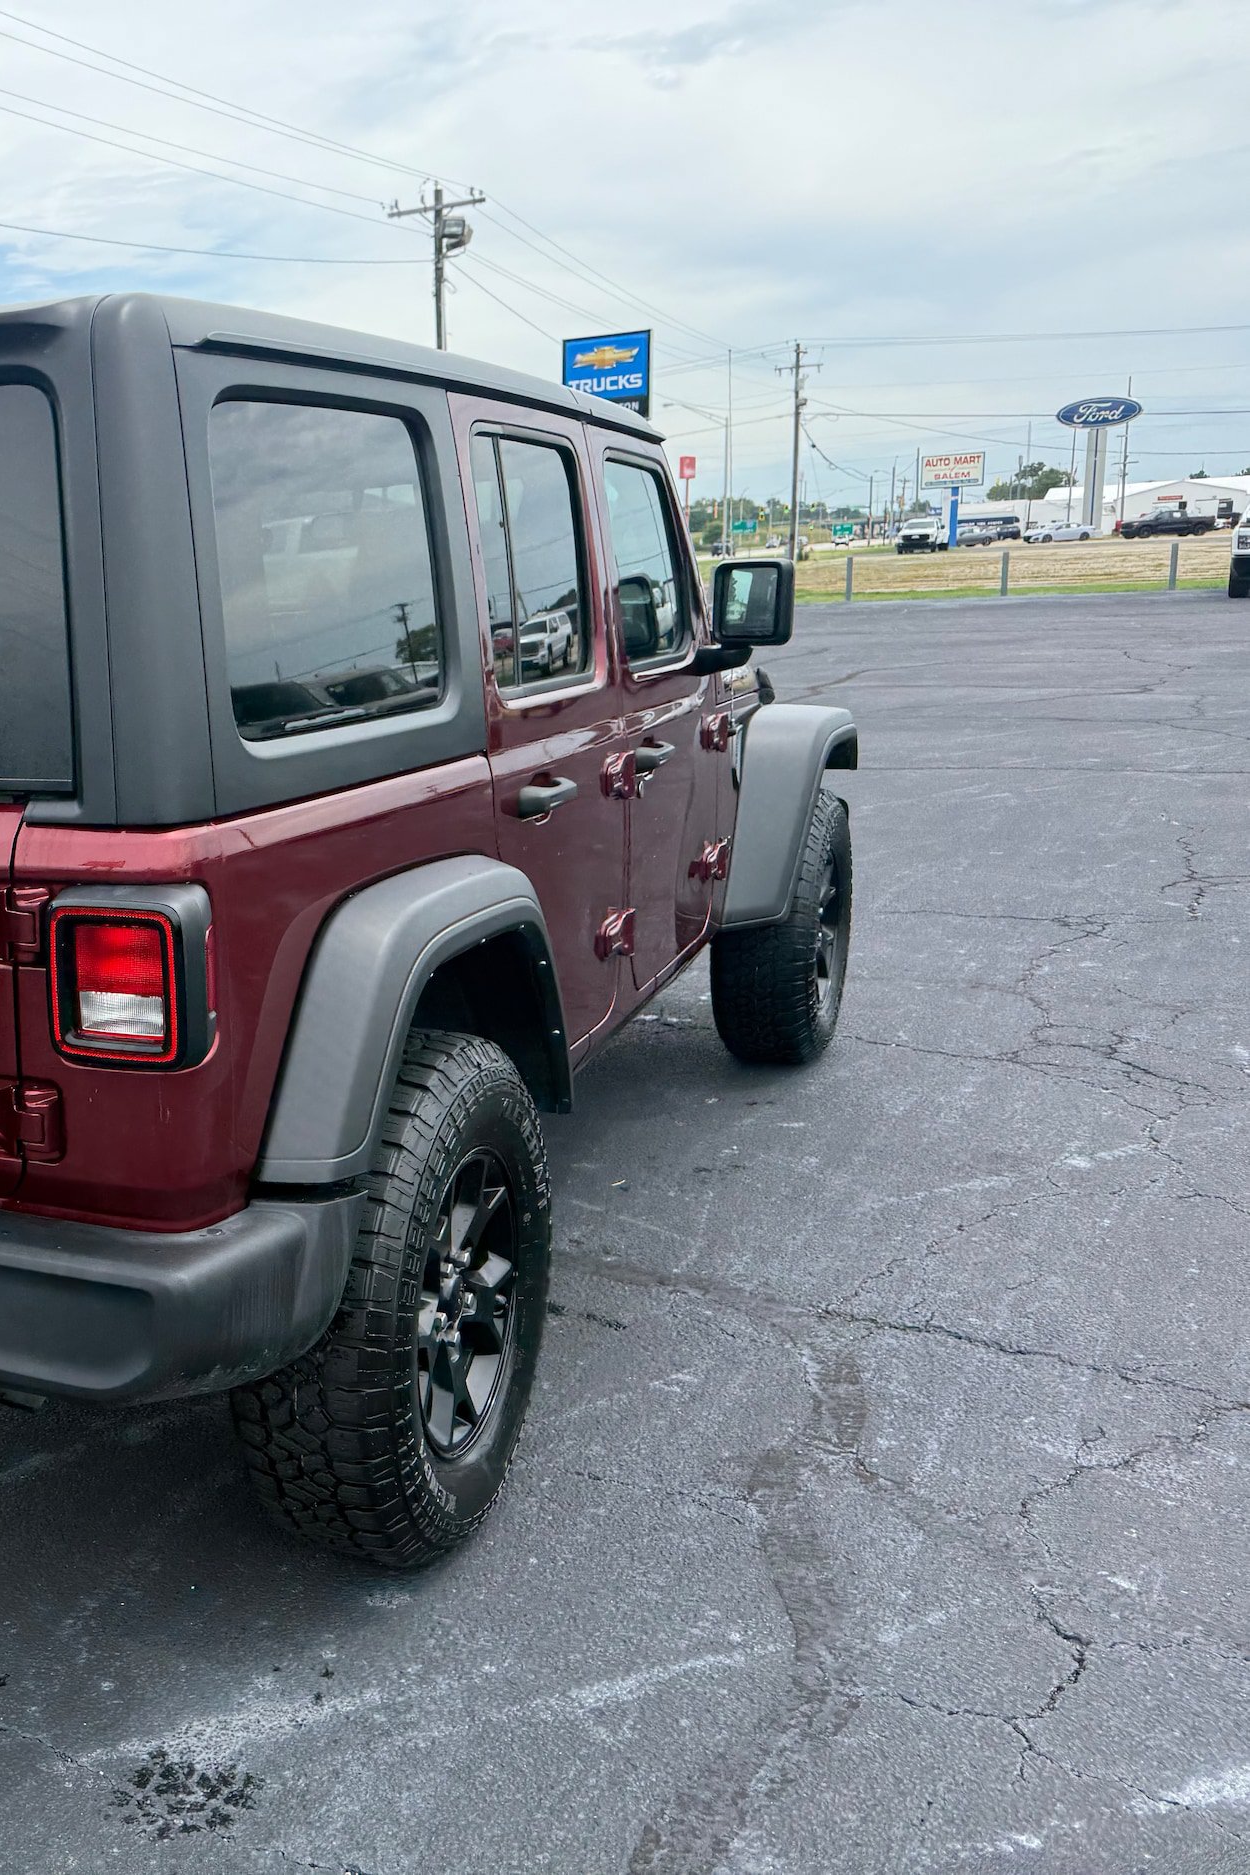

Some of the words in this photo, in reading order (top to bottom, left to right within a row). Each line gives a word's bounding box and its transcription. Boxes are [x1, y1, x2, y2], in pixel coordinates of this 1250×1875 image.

[568, 373, 643, 393] TRUCKS
[1073, 402, 1125, 423] Ford
[925, 457, 951, 467] AUTO
[953, 455, 981, 465] MART
